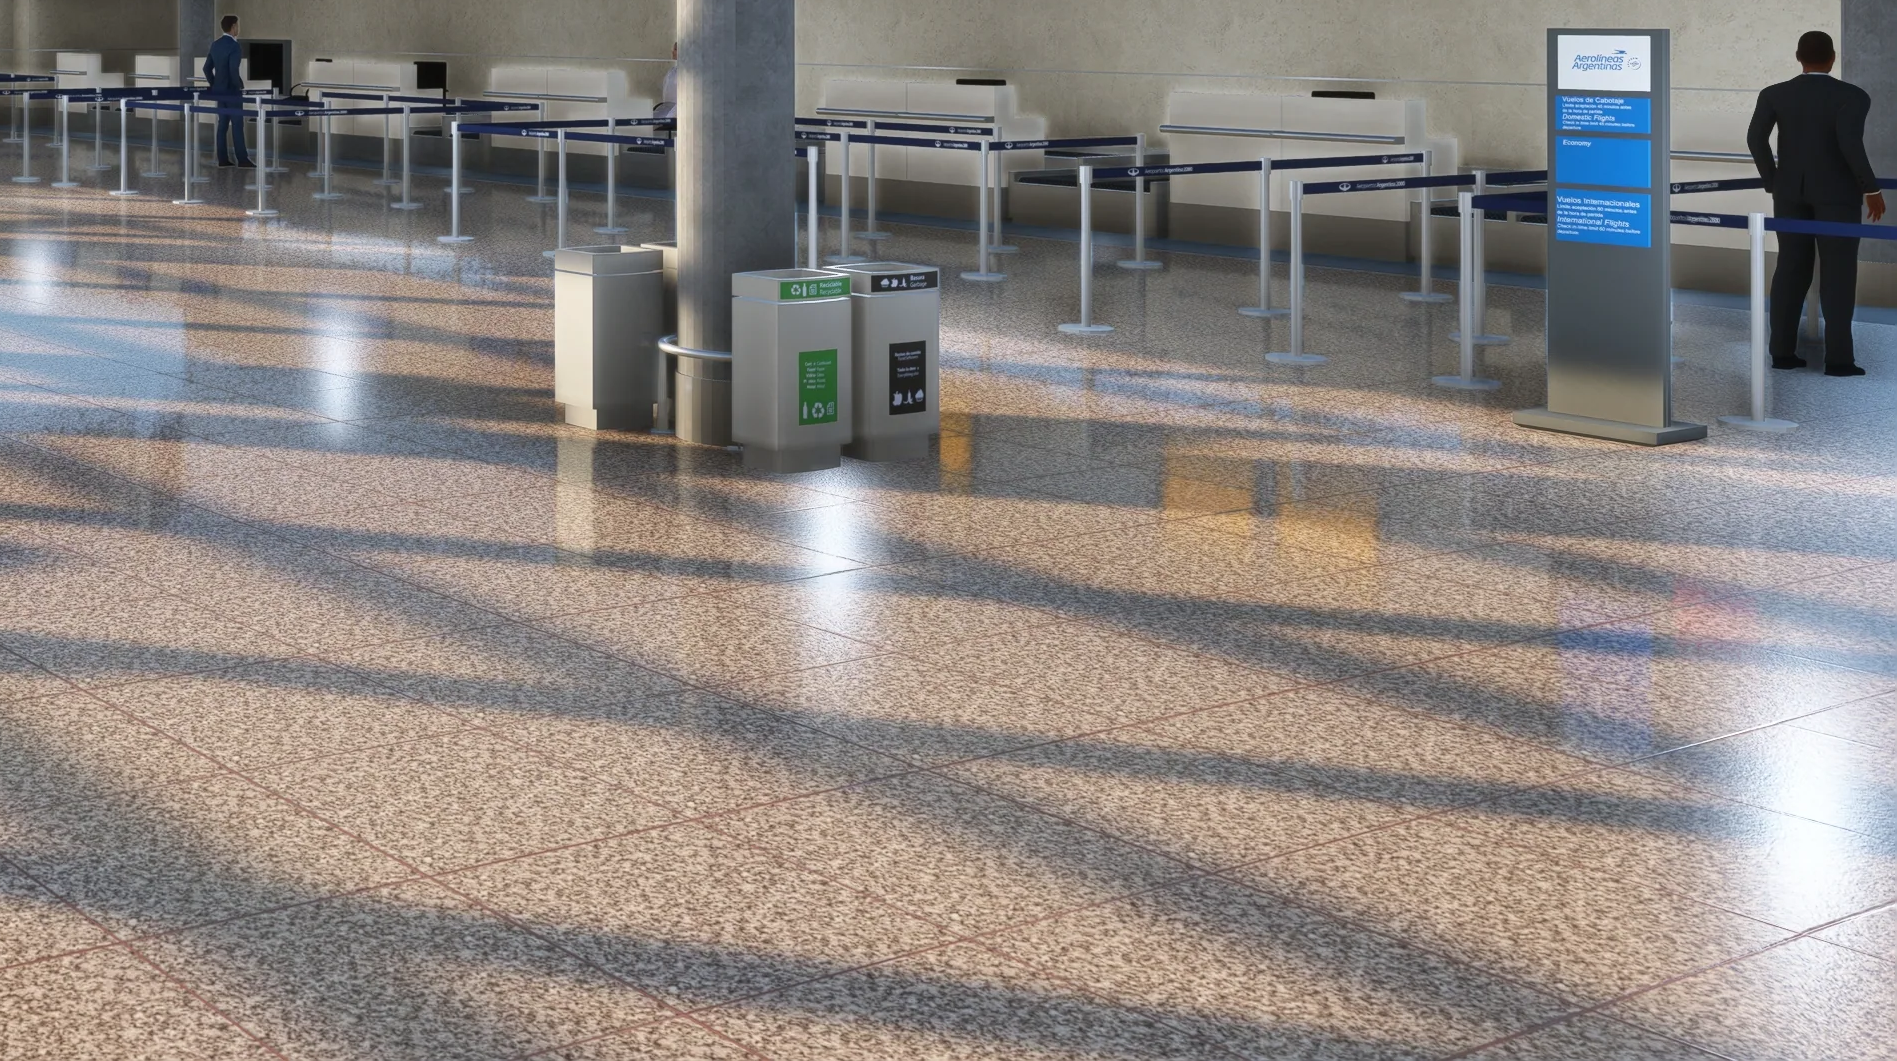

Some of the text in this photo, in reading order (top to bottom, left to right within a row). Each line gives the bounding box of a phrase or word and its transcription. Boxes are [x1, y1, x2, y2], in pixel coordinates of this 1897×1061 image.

[1574, 54, 1624, 63] Aerolíneas
[1572, 62, 1622, 71] Argentinas
[1595, 97, 1624, 105] Cabotaje
[1593, 114, 1615, 122] Flights
[1563, 139, 1591, 147] Economy
[1557, 196, 1640, 208] Vuelos Internacionales
[1557, 216, 1630, 228] International Flights
